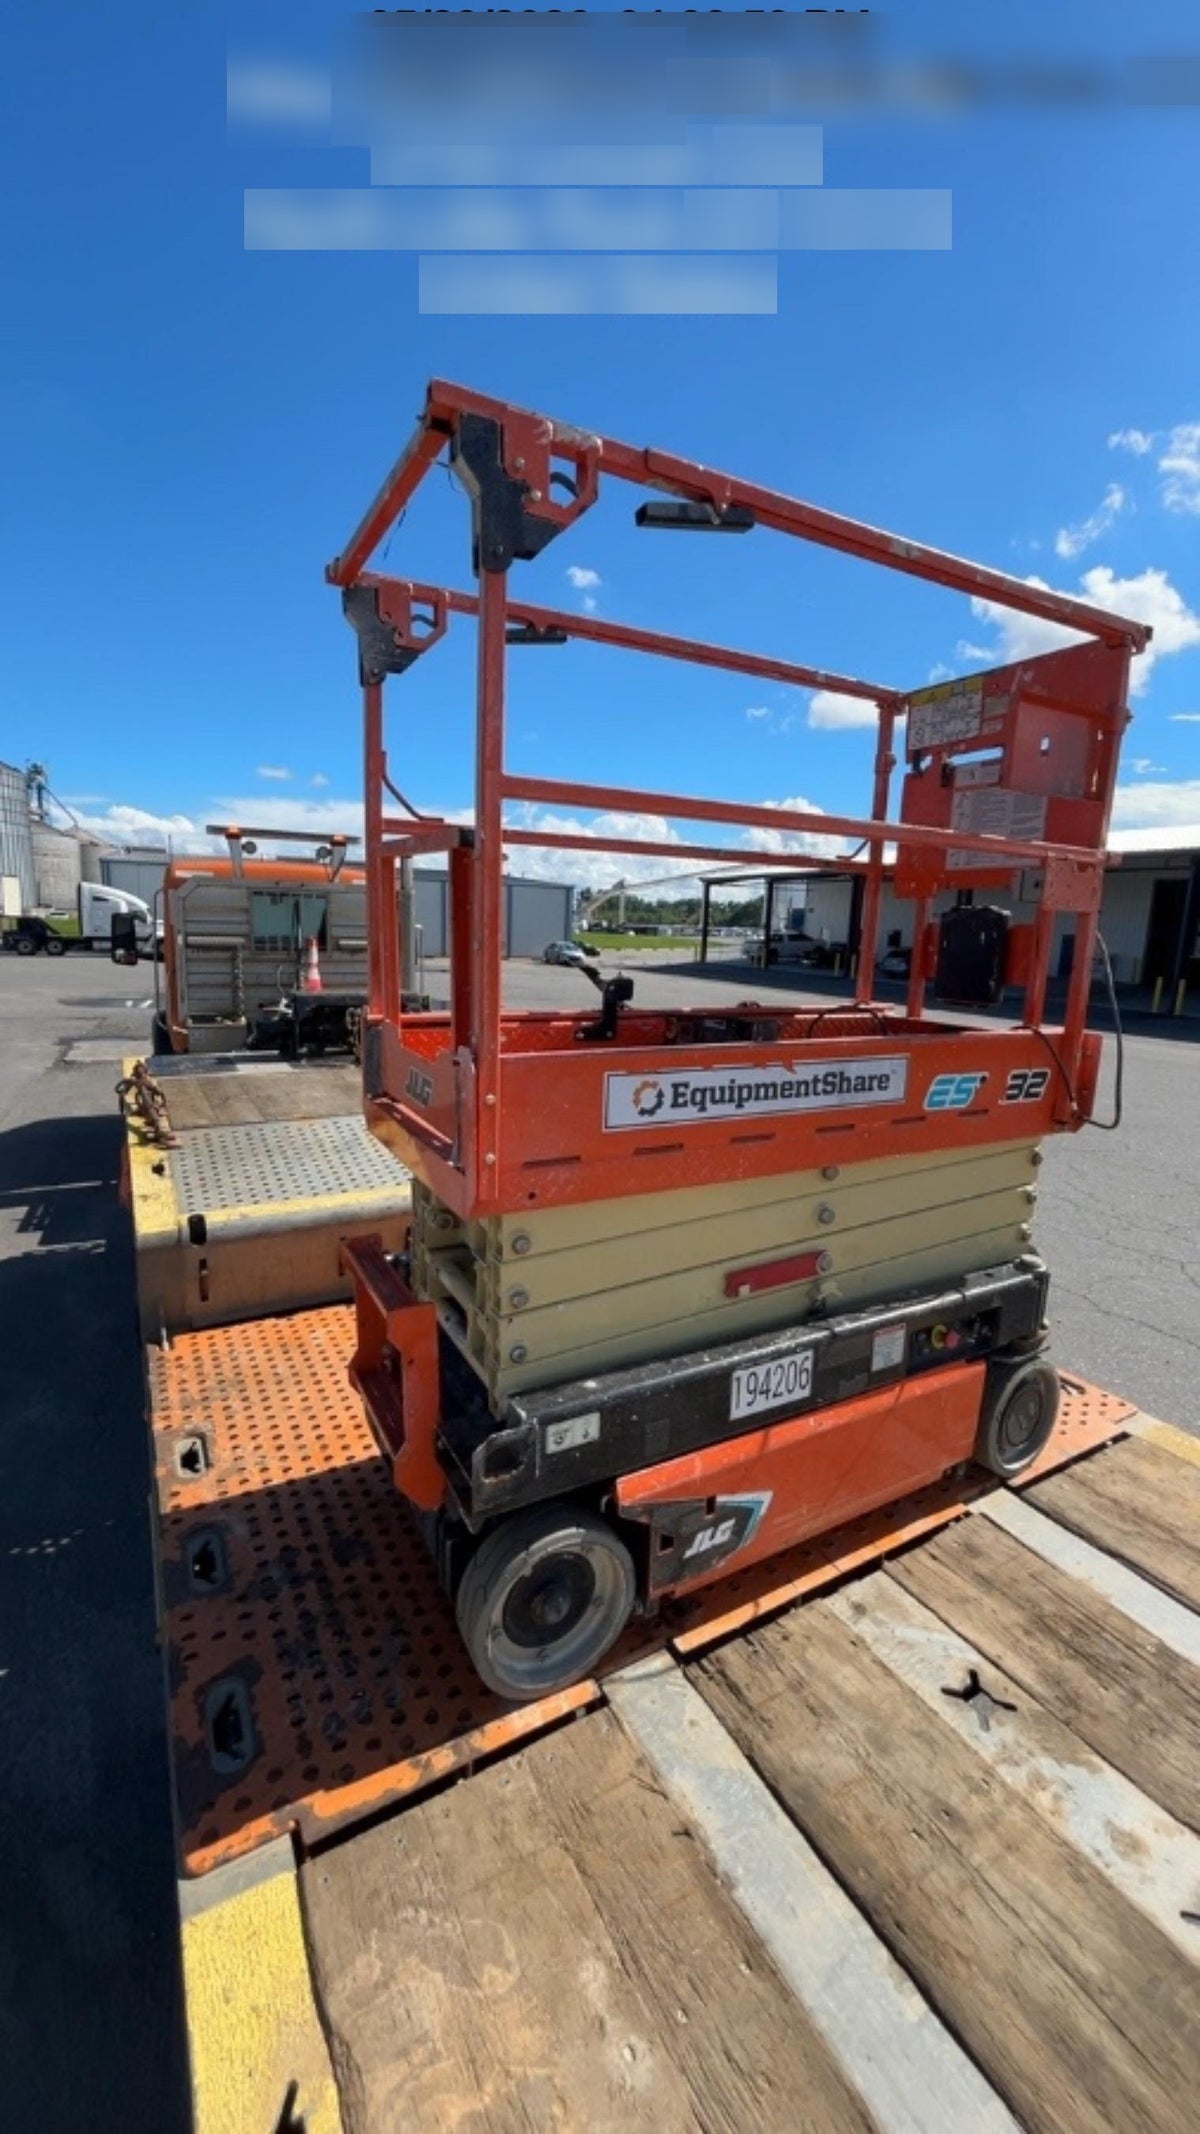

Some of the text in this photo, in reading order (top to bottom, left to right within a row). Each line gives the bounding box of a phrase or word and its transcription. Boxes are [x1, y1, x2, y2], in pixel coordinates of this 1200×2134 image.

[670, 1071, 890, 1113] EquipmentShare
[1005, 1070, 1049, 1101] 32
[735, 1355, 809, 1411] 194206
[682, 1518, 736, 1559] JLG
